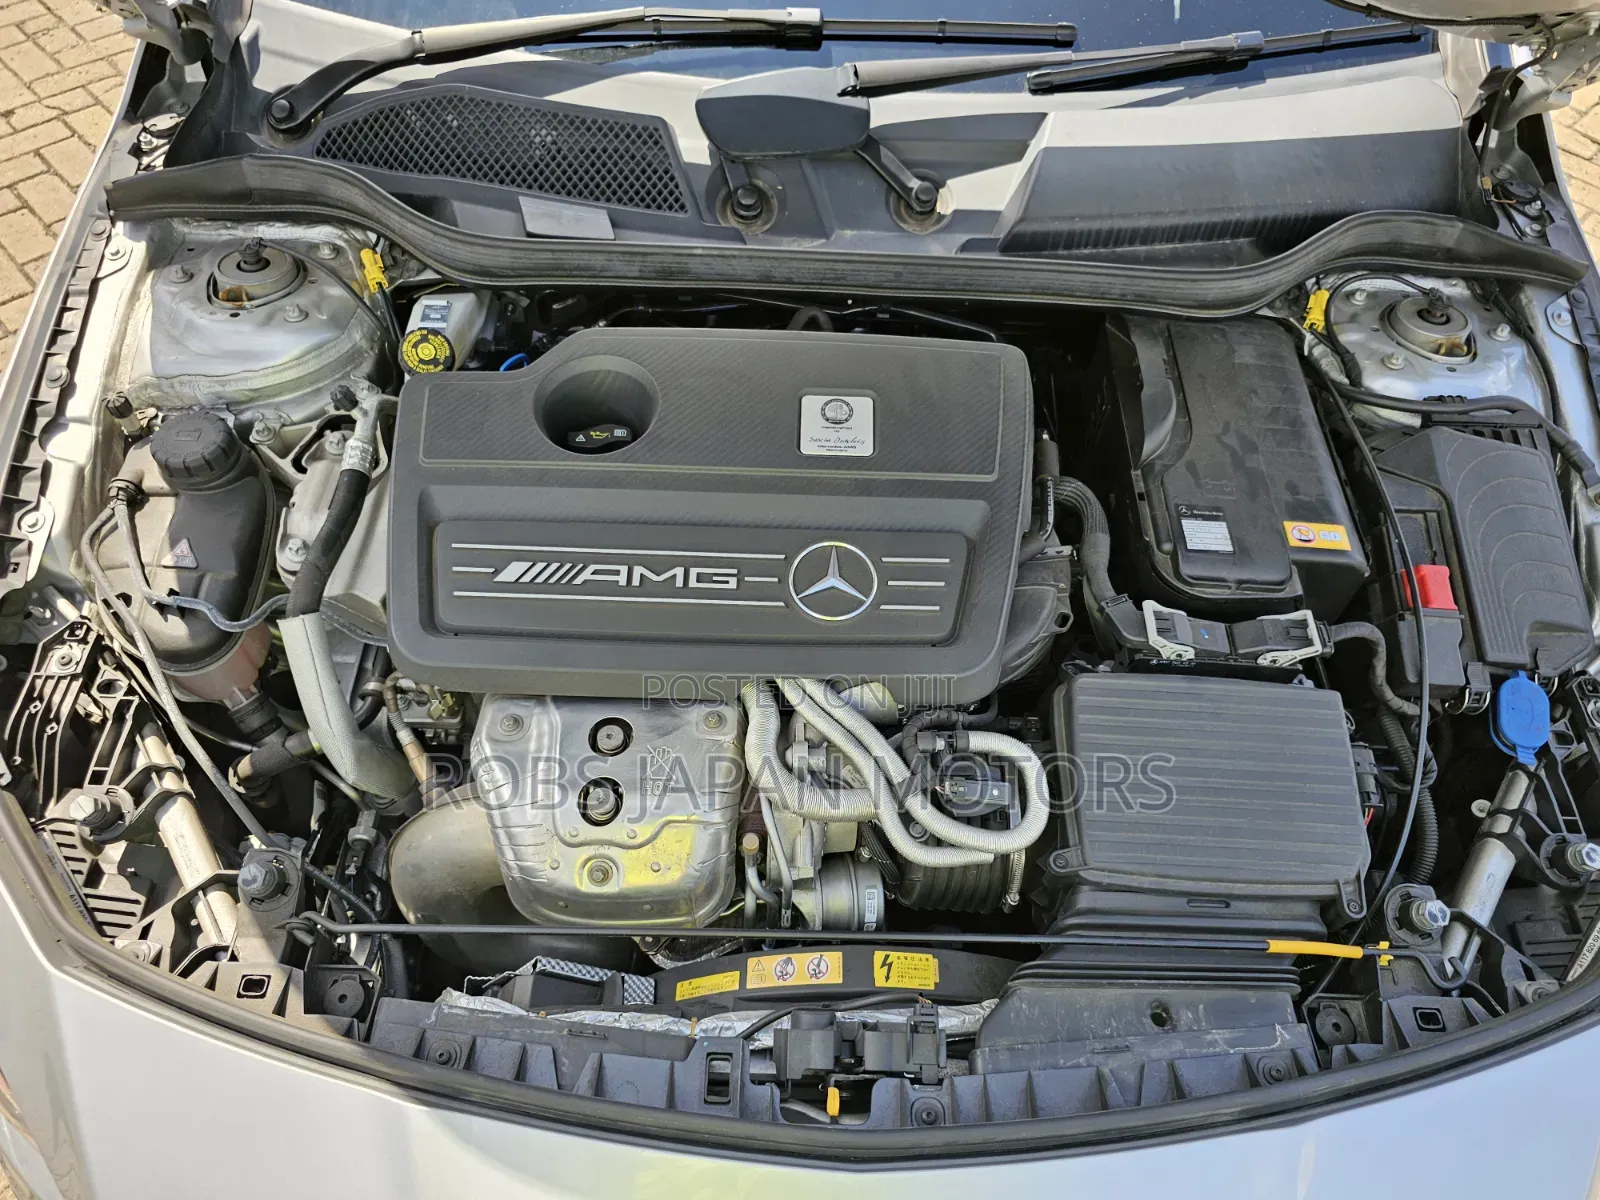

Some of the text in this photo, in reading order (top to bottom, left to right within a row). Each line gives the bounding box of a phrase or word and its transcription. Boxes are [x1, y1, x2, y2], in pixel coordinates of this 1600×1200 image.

[573, 565, 738, 589] AMG
[642, 781, 675, 796] HOT
[1577, 954, 1590, 969] A117
[1586, 943, 1595, 953] 820
